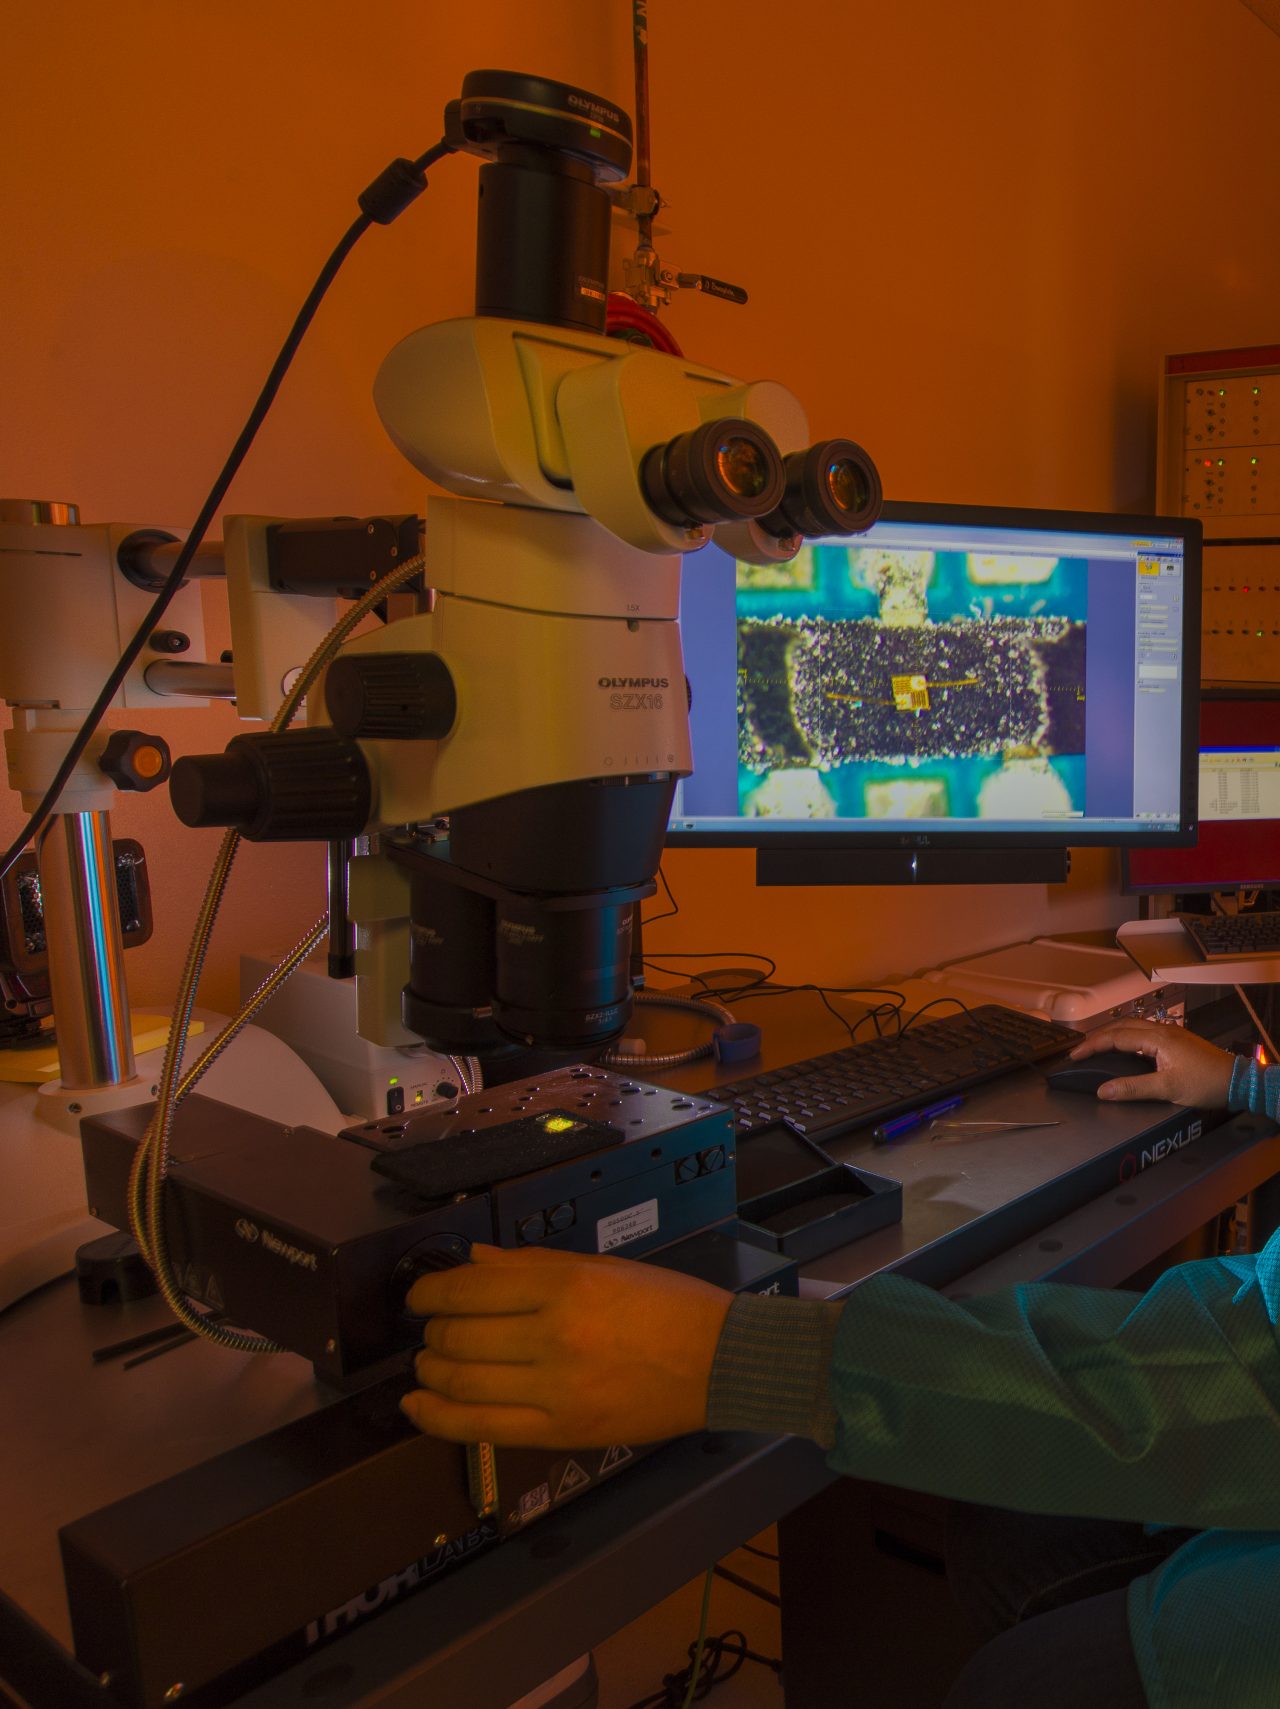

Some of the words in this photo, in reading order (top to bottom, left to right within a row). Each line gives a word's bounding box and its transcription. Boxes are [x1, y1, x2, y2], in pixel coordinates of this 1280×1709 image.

[567, 95, 619, 122] OLYMPUS
[598, 677, 668, 687] OLYMPUS
[610, 693, 663, 710] SZX16
[1141, 1119, 1202, 1169] NEXUS
[262, 1230, 317, 1272] Newport
